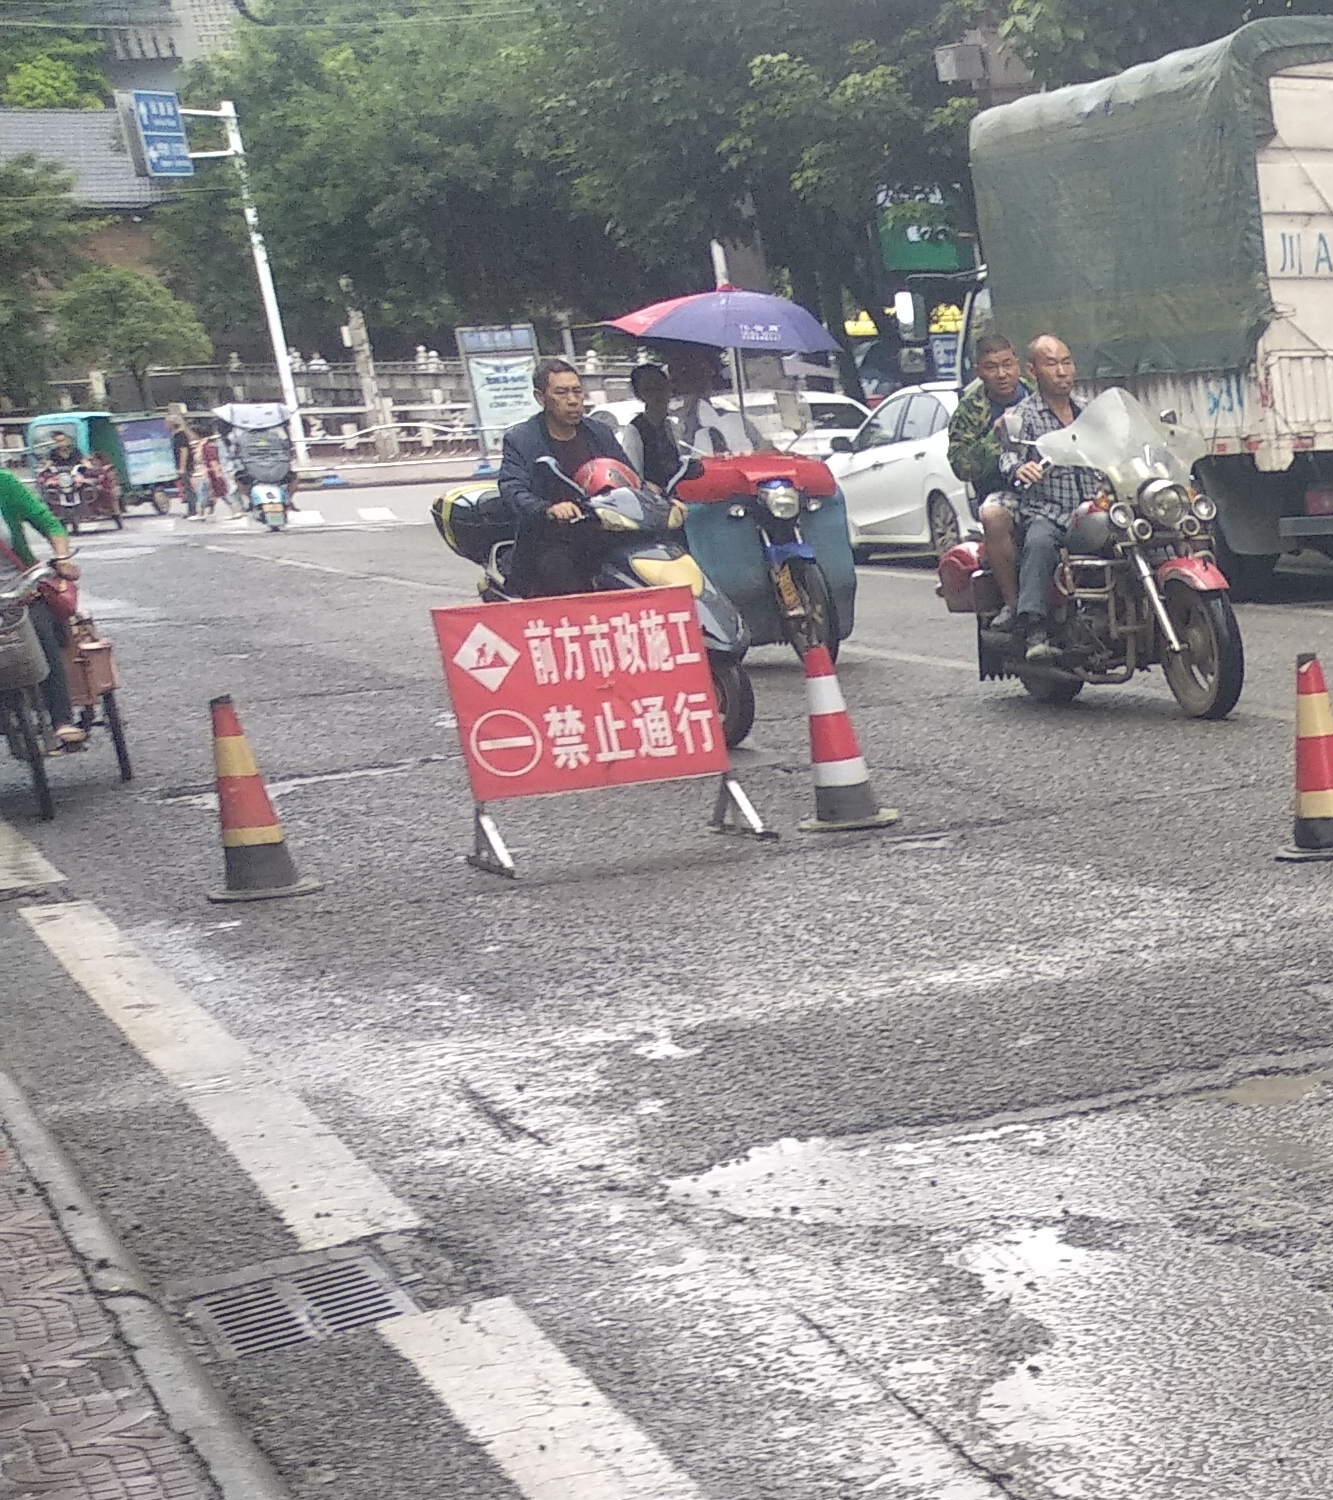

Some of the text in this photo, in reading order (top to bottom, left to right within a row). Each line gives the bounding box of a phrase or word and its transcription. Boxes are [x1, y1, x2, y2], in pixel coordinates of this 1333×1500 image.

[523, 609, 701, 685] 前方市政施工
[543, 691, 714, 769] 禁止通行
